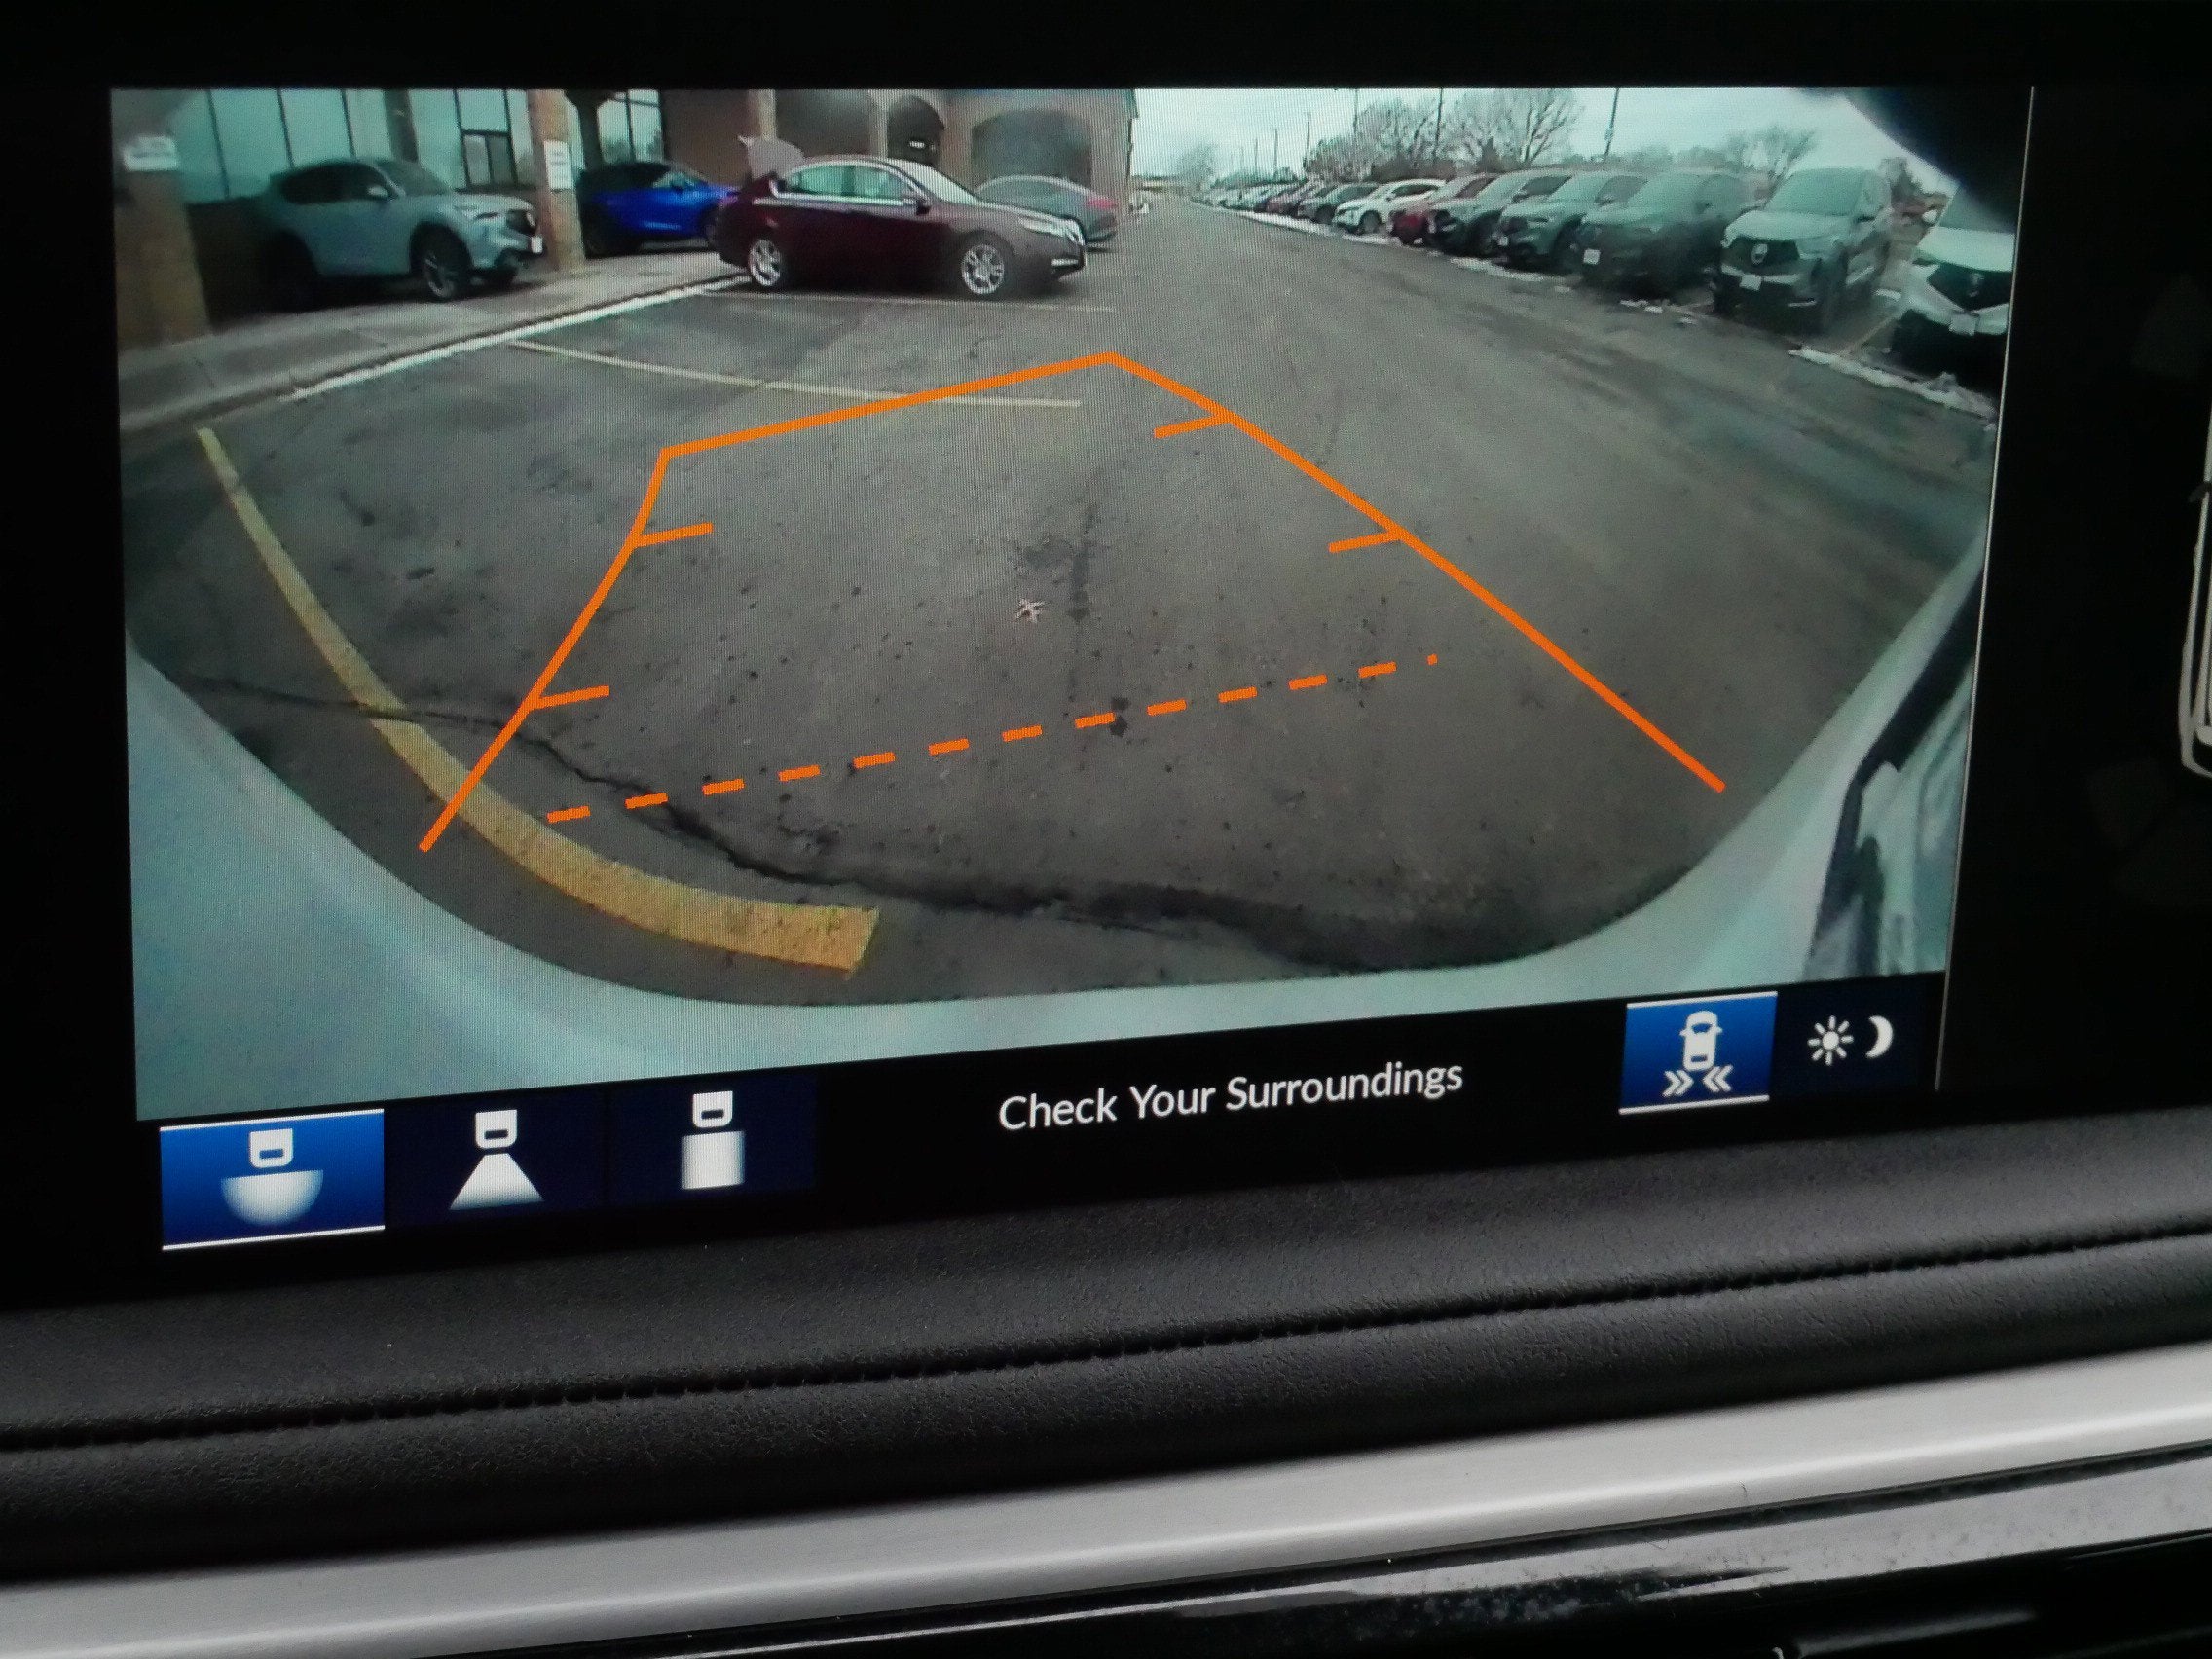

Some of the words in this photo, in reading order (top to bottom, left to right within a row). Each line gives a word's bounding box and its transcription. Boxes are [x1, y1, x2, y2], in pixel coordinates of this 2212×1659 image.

[999, 1088, 1117, 1130] Check
[1129, 1085, 1216, 1119] Your
[1226, 1061, 1463, 1111] Surroundings
